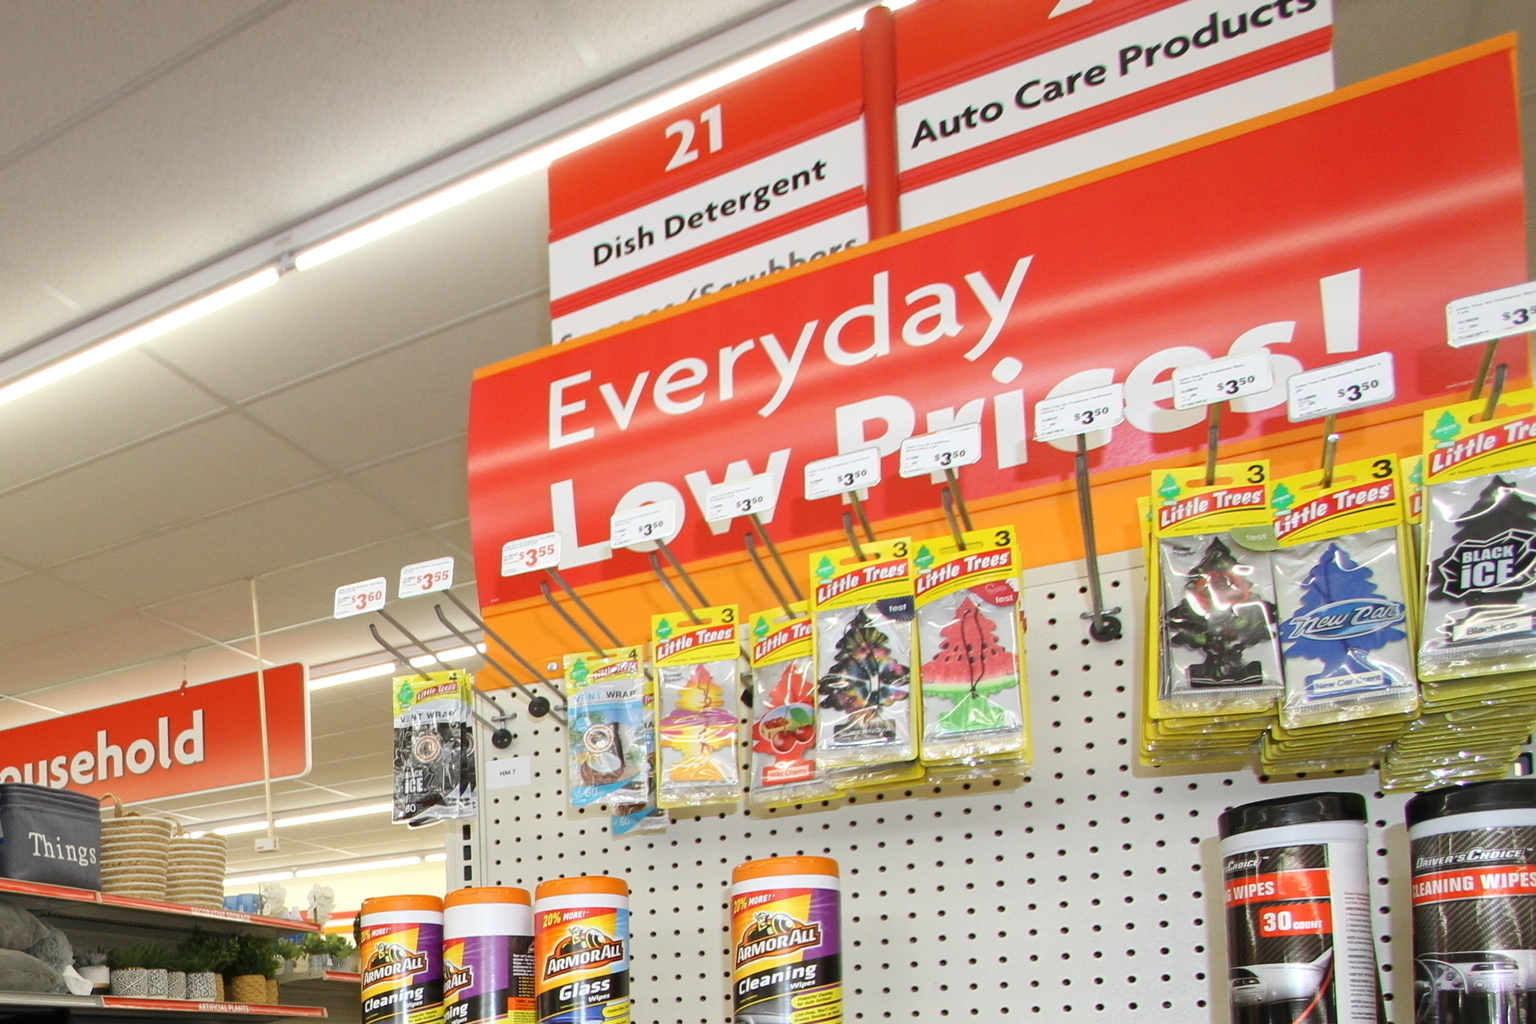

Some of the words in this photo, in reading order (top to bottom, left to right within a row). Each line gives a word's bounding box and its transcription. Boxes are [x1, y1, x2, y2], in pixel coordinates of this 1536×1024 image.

[910, 100, 1004, 150] Auto
[1014, 64, 1107, 111] Care
[1118, 0, 1318, 76] Products
[664, 104, 724, 172] 21
[593, 226, 654, 266] Dish
[664, 159, 827, 239] Detergent
[548, 254, 1034, 450] Everyday
[1432, 433, 1497, 473] Little
[1161, 498, 1208, 526] Little
[1213, 489, 1263, 508] Trees
[1275, 503, 1327, 537] Little
[1333, 483, 1392, 510] Trees
[893, 542, 907, 557] 3
[1462, 545, 1514, 564] BLACK
[817, 575, 859, 605] Little
[863, 562, 907, 583] Trees
[918, 565, 960, 594] Little
[964, 552, 1010, 572] Trees
[722, 609, 734, 623] 3
[657, 637, 692, 659] Little
[695, 628, 734, 644] Trees
[755, 631, 788, 659] Little
[417, 688, 436, 701] Little
[438, 682, 457, 693] Trees
[1315, 681, 1335, 690] New
[1337, 679, 1353, 687] Car
[400, 713, 423, 723] VENT
[426, 710, 454, 719] WRAP
[784, 767, 807, 777] Cherry
[28, 831, 96, 867] Things
[1234, 881, 1275, 900] WIPES
[543, 912, 561, 928] 20%
[563, 911, 586, 921] MORE!
[1263, 911, 1291, 932] 30
[1293, 920, 1322, 930] COUNT
[559, 979, 610, 1001] Glass
[739, 964, 817, 995] Cleaning
[790, 978, 816, 989] Wipes
[365, 988, 423, 1013] Cleaning
[588, 992, 610, 1003] Wipes
